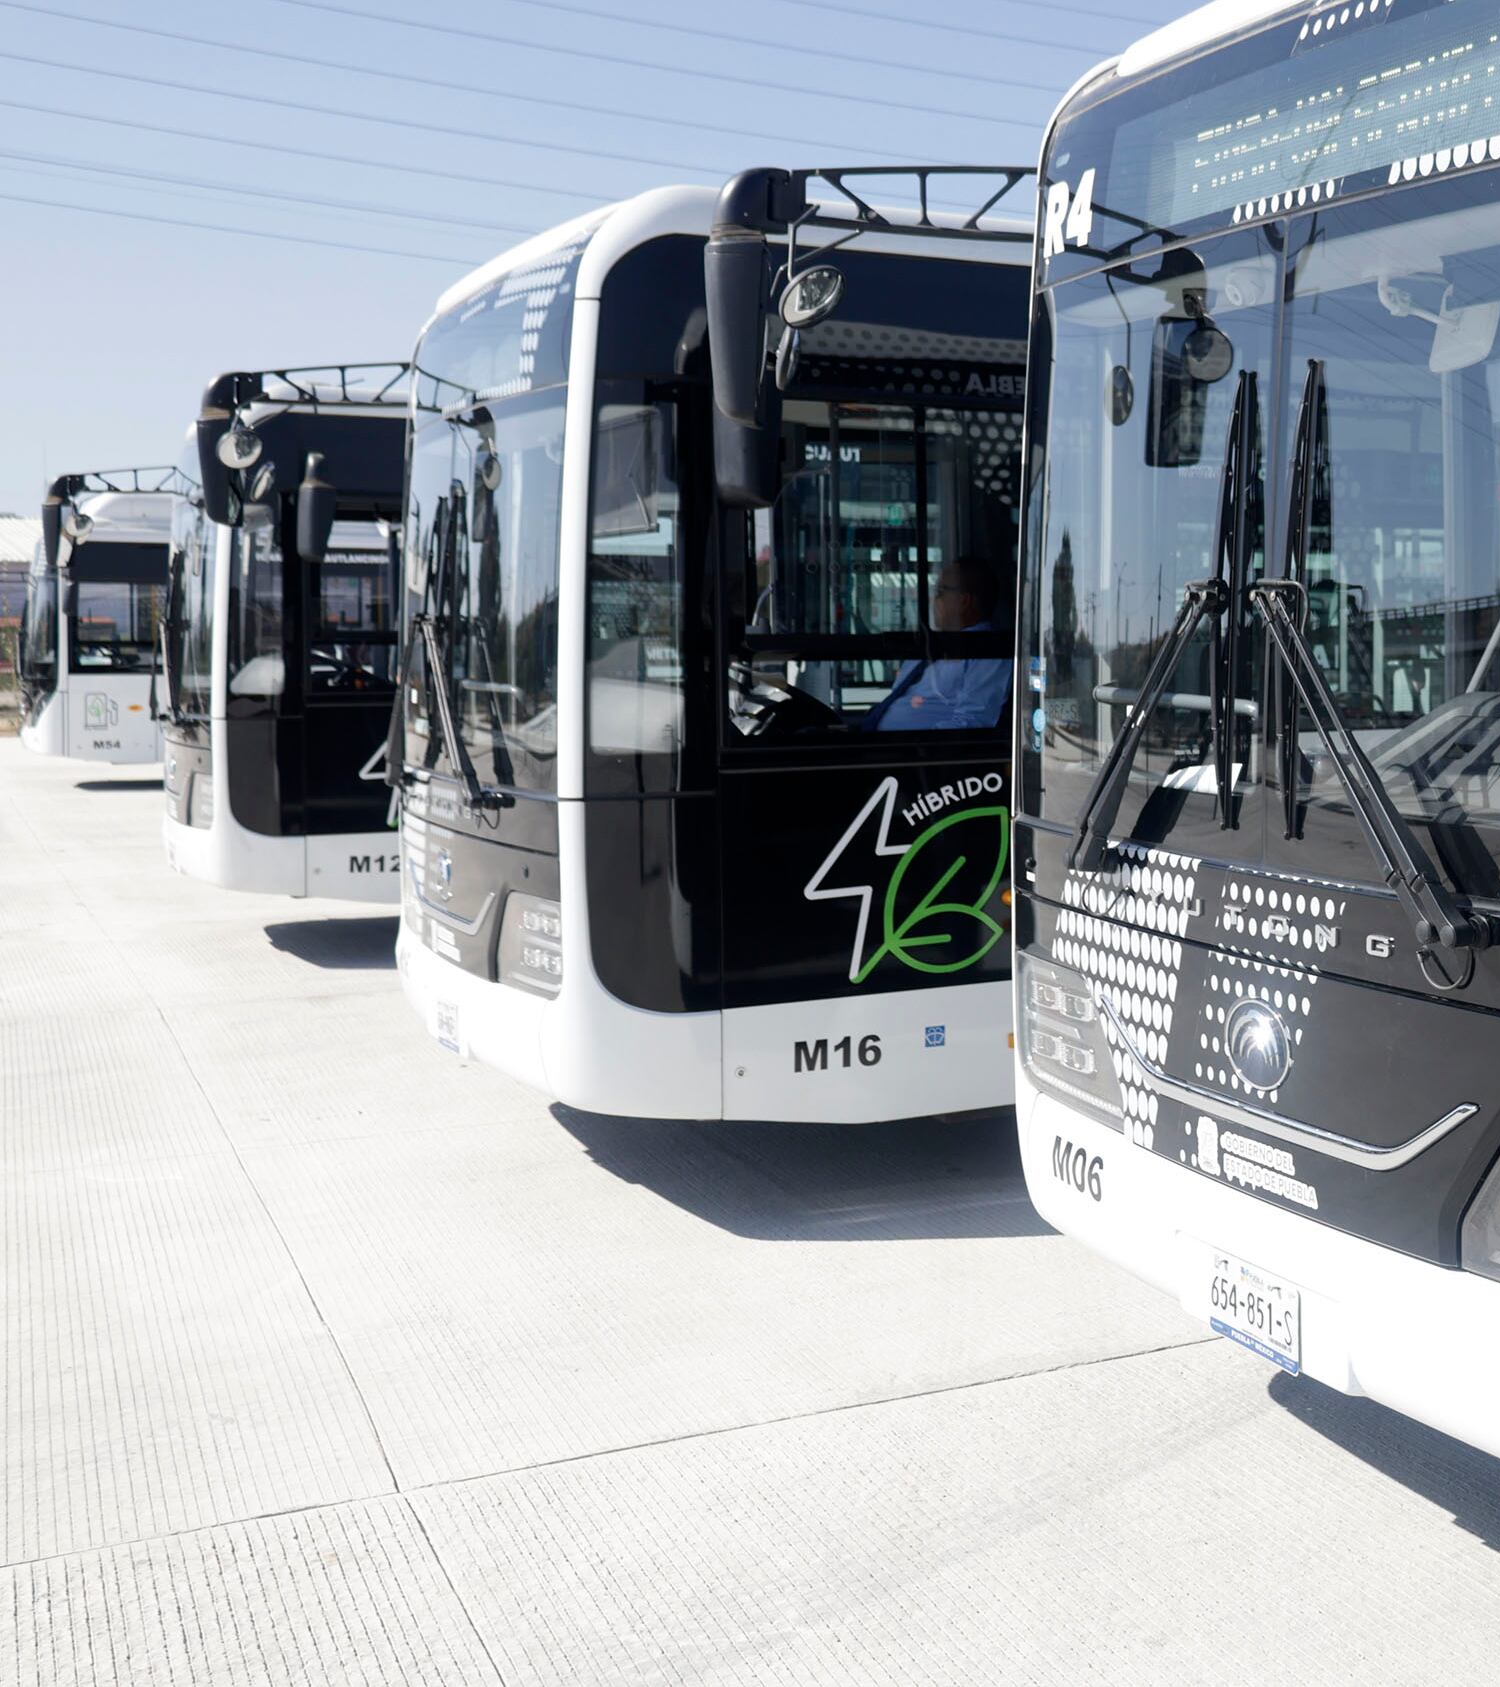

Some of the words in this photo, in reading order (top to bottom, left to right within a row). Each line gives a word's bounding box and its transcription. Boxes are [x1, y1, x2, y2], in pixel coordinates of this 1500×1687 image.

[1043, 167, 1096, 259] R4
[93, 740, 121, 750] M54
[902, 772, 1003, 826] HÍBRIDO
[349, 855, 400, 873] M12
[794, 1034, 882, 1074] M16
[1052, 1135, 1104, 1202] M06
[1225, 1135, 1273, 1164] GOBIERNO
[1275, 1154, 1293, 1172] DEL
[1225, 1157, 1262, 1184] ESTADO
[1264, 1173, 1276, 1189] DE
[1278, 1178, 1316, 1203] PUEBLA
[1211, 1275, 1294, 1347] 654-851-S
